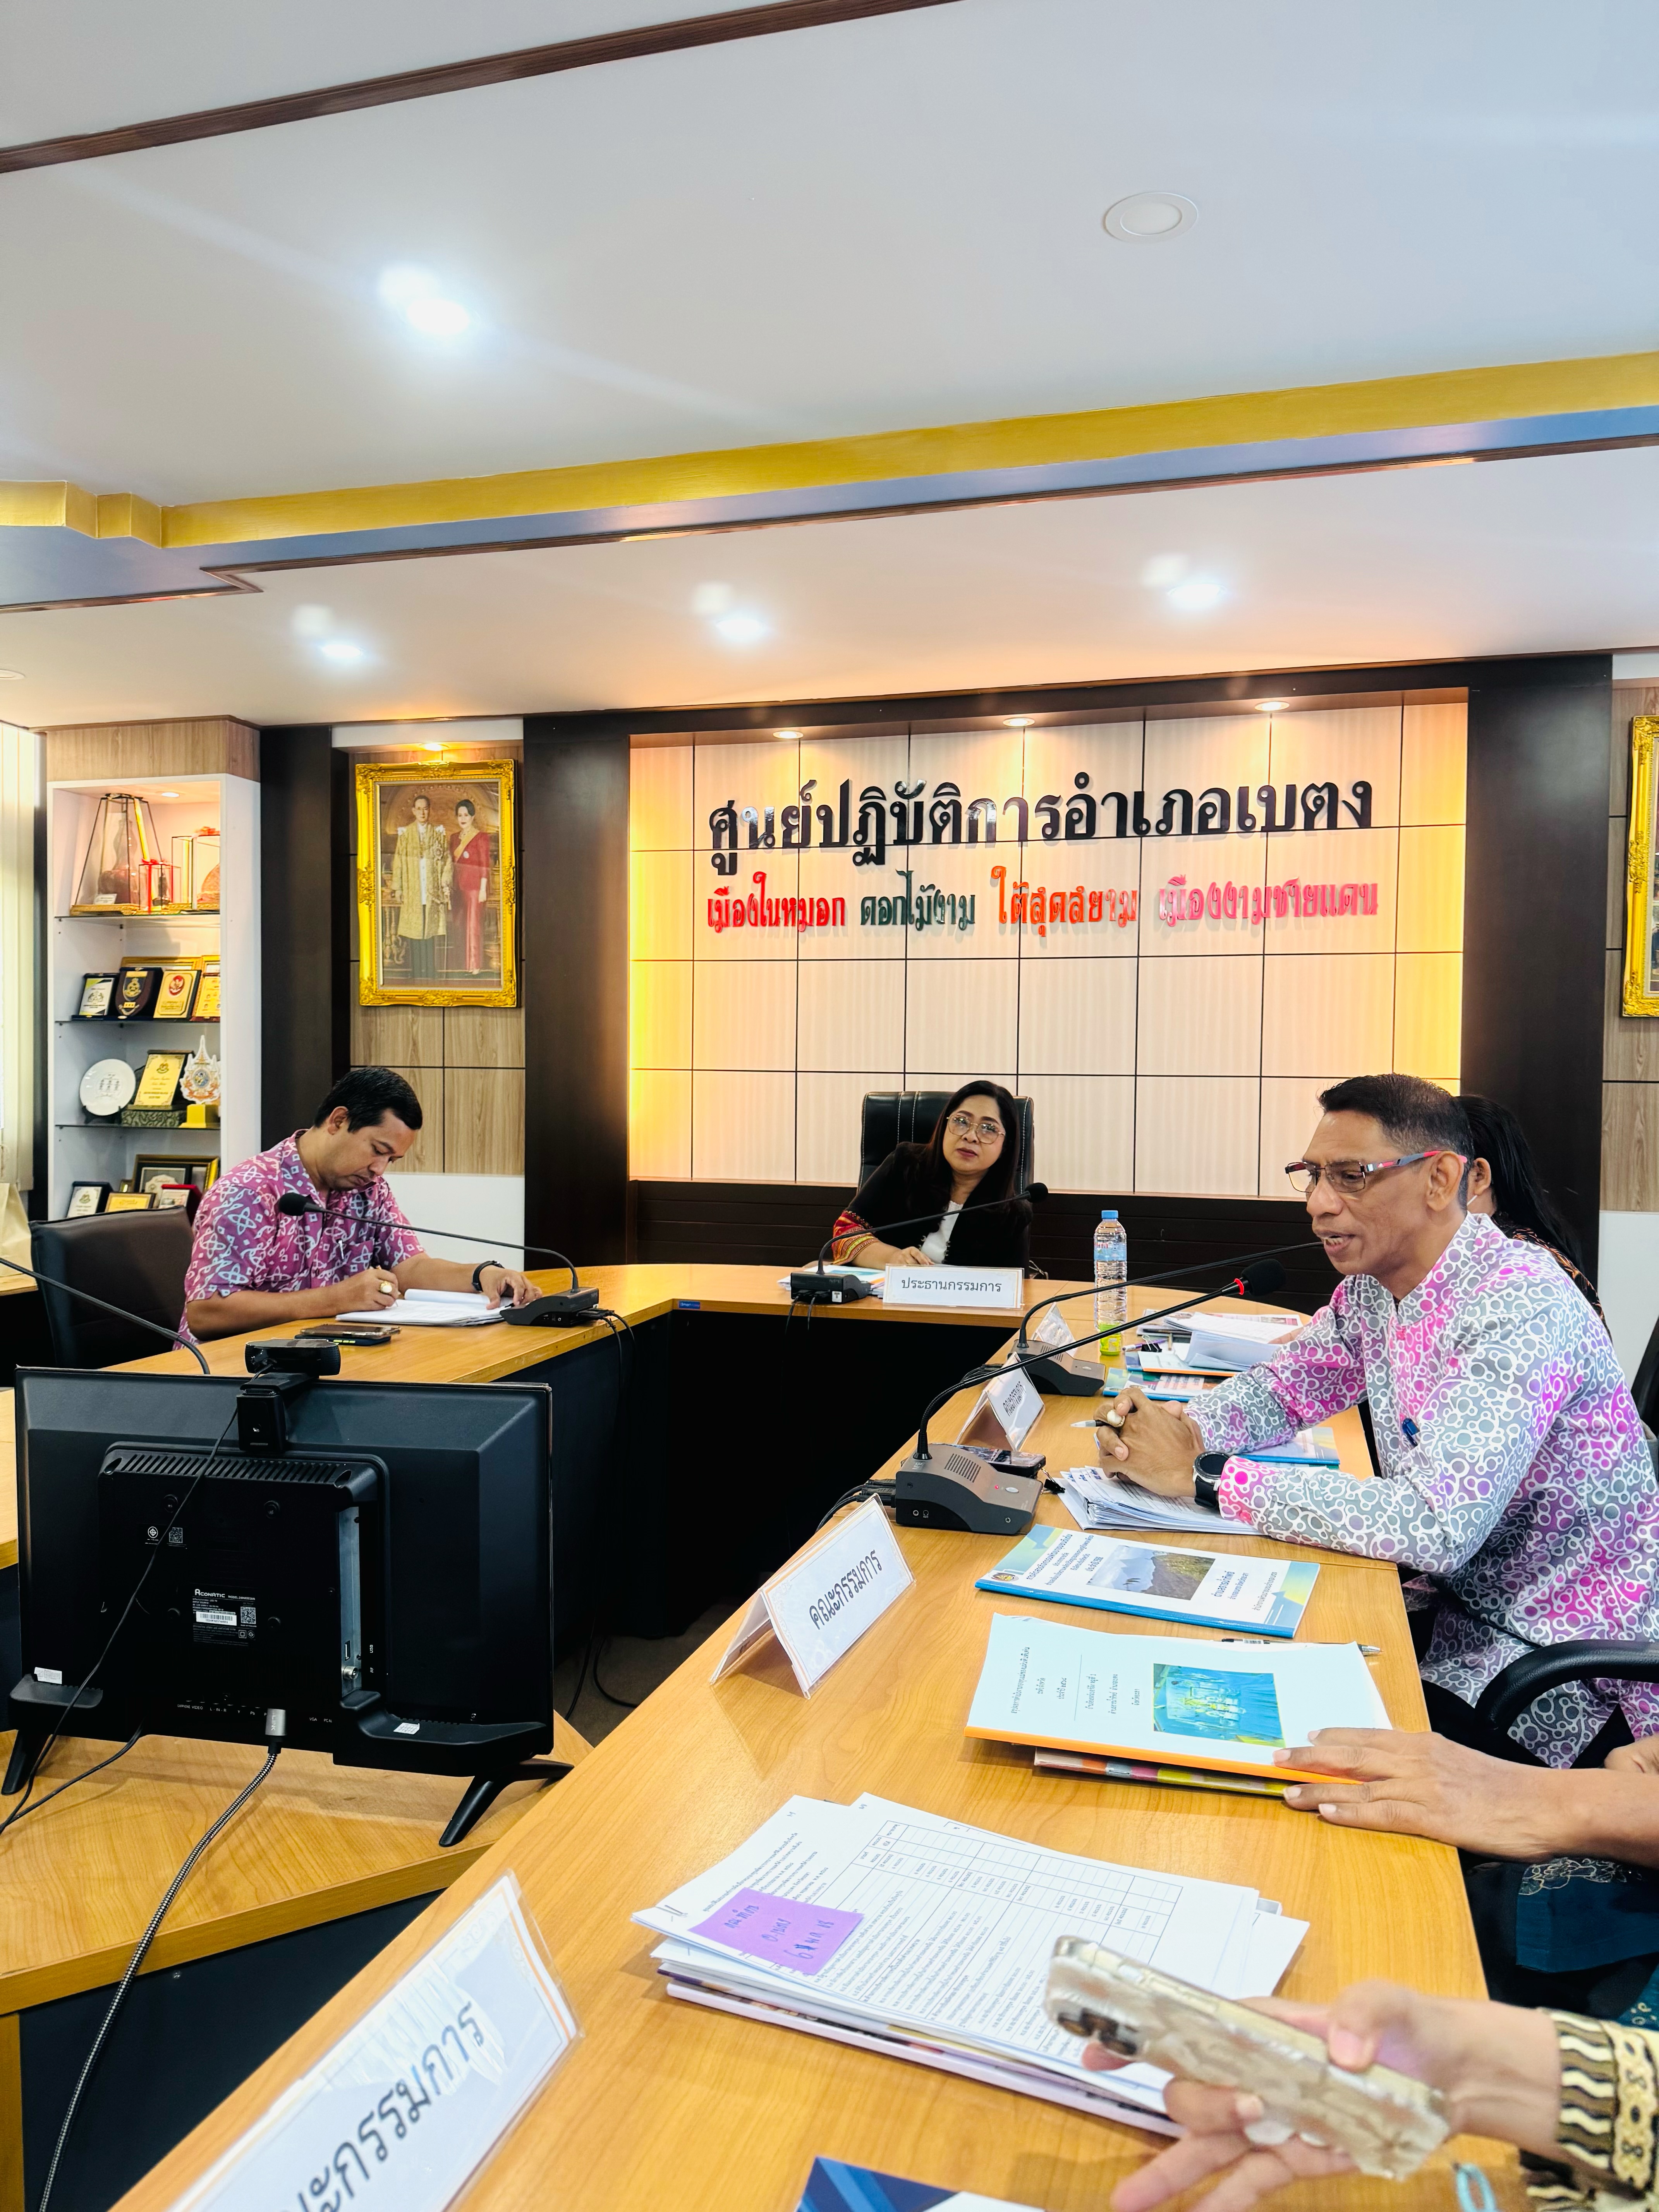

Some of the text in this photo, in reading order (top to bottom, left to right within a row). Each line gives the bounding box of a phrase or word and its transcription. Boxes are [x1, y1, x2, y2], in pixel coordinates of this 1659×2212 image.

[709, 772, 1372, 875] ศูนย์ปฏิบัติการอำเภอเบตง
[707, 866, 1378, 937] เมืองในหมอก ดอกไม้งาม ใต้สุดสยาม เมืองงามชายแดน
[902, 1277, 1002, 1292] ประธานกรรมการ
[809, 1550, 883, 1630] คณะกรรมการ
[283, 2001, 485, 2212] ะกรรมการ
